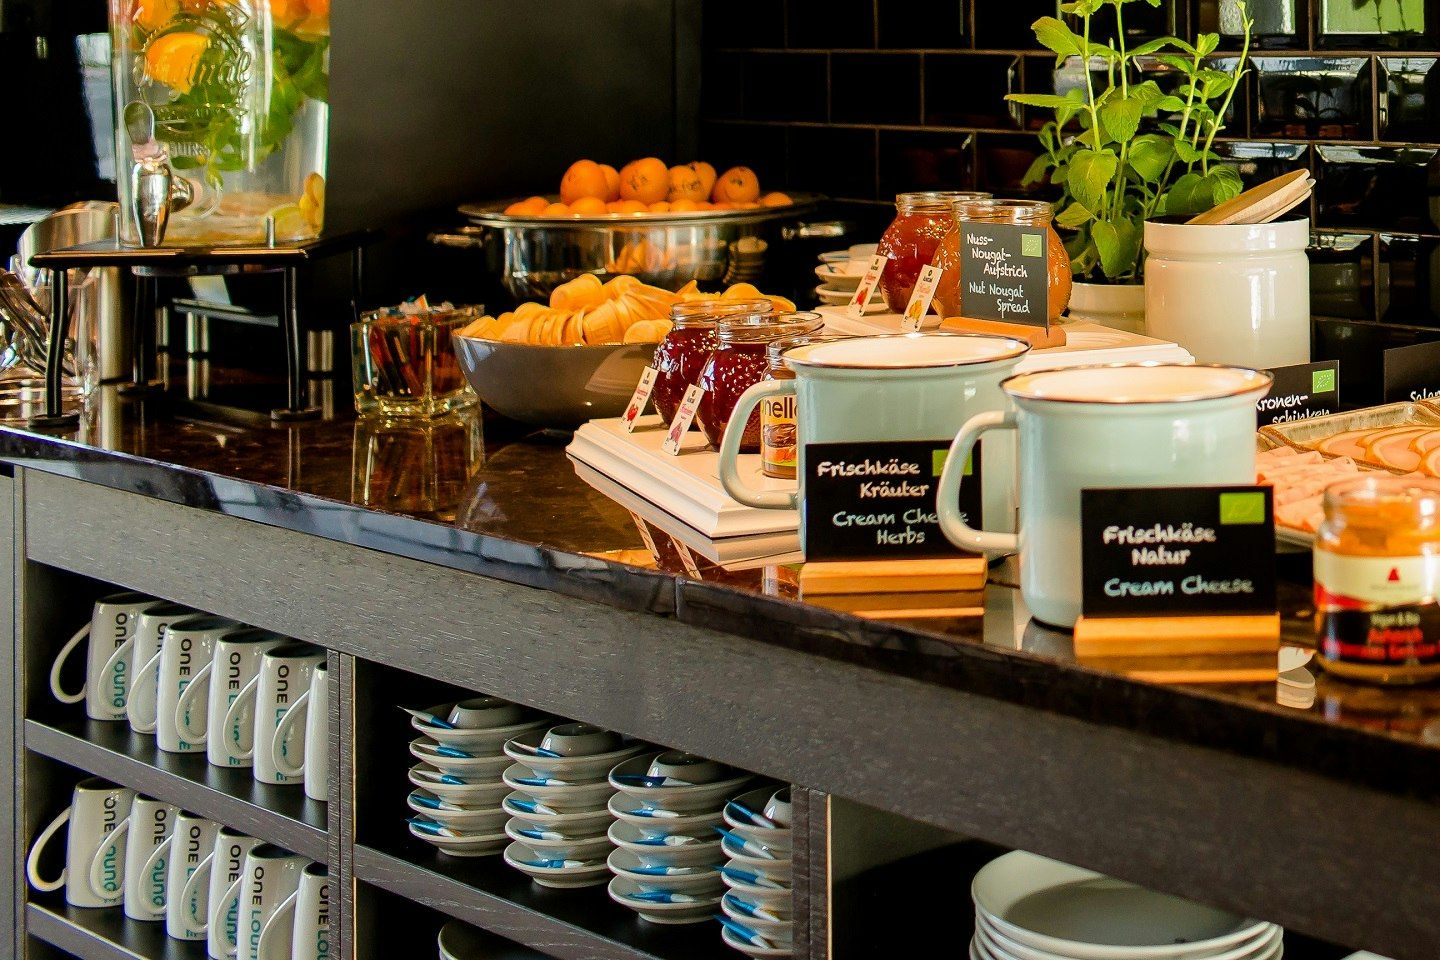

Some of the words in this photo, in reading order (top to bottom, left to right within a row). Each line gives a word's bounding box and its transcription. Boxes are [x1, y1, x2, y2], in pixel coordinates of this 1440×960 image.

[966, 233, 994, 246] Nuss-
[971, 247, 1012, 265] Nougat-
[983, 260, 1029, 280] Aufstrich
[969, 280, 987, 295] Nut
[989, 283, 1025, 302] Nougat
[996, 298, 1031, 319] Spread
[817, 458, 921, 477] Frischkäse
[859, 480, 930, 500] Kräuter
[832, 510, 896, 528] Cream
[902, 507, 970, 525] Chee
[876, 525, 926, 545] Herbs
[1102, 522, 1218, 545] Frischkäse
[1131, 544, 1192, 566] Natur
[1103, 577, 1175, 598] Cream
[1180, 574, 1255, 596] Cheese
[179, 638, 192, 676] ONE
[228, 651, 241, 690] ONE
[276, 665, 289, 704] ONE
[188, 825, 200, 863] ONE
[252, 866, 264, 906] ONE
